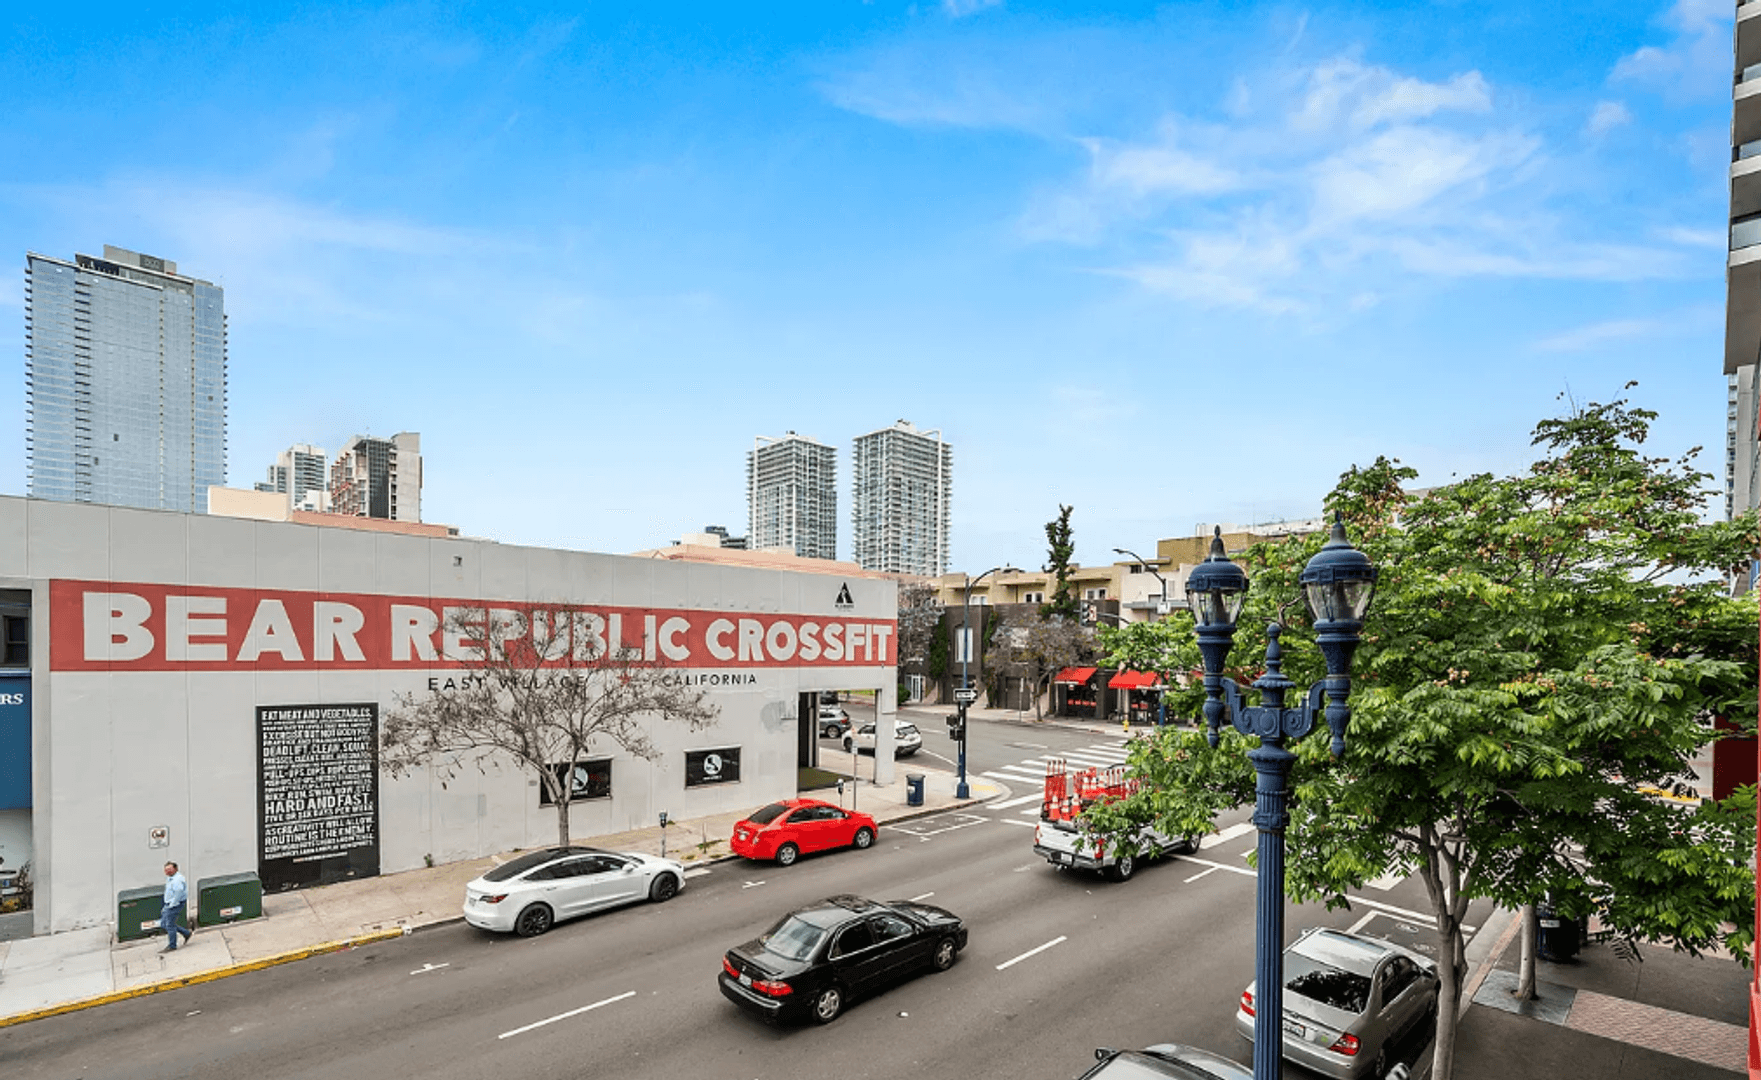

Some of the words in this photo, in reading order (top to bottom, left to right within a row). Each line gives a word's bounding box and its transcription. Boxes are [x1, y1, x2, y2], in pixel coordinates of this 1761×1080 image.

[83, 591, 366, 662] BEAR
[391, 604, 691, 662] REPUBLIC
[705, 617, 893, 662] CROSSFIT
[428, 677, 484, 690] EAST
[661, 674, 757, 687] CALIFORNIA
[0, 693, 24, 705] RS
[264, 800, 305, 815] HARD
[306, 796, 336, 810] AND
